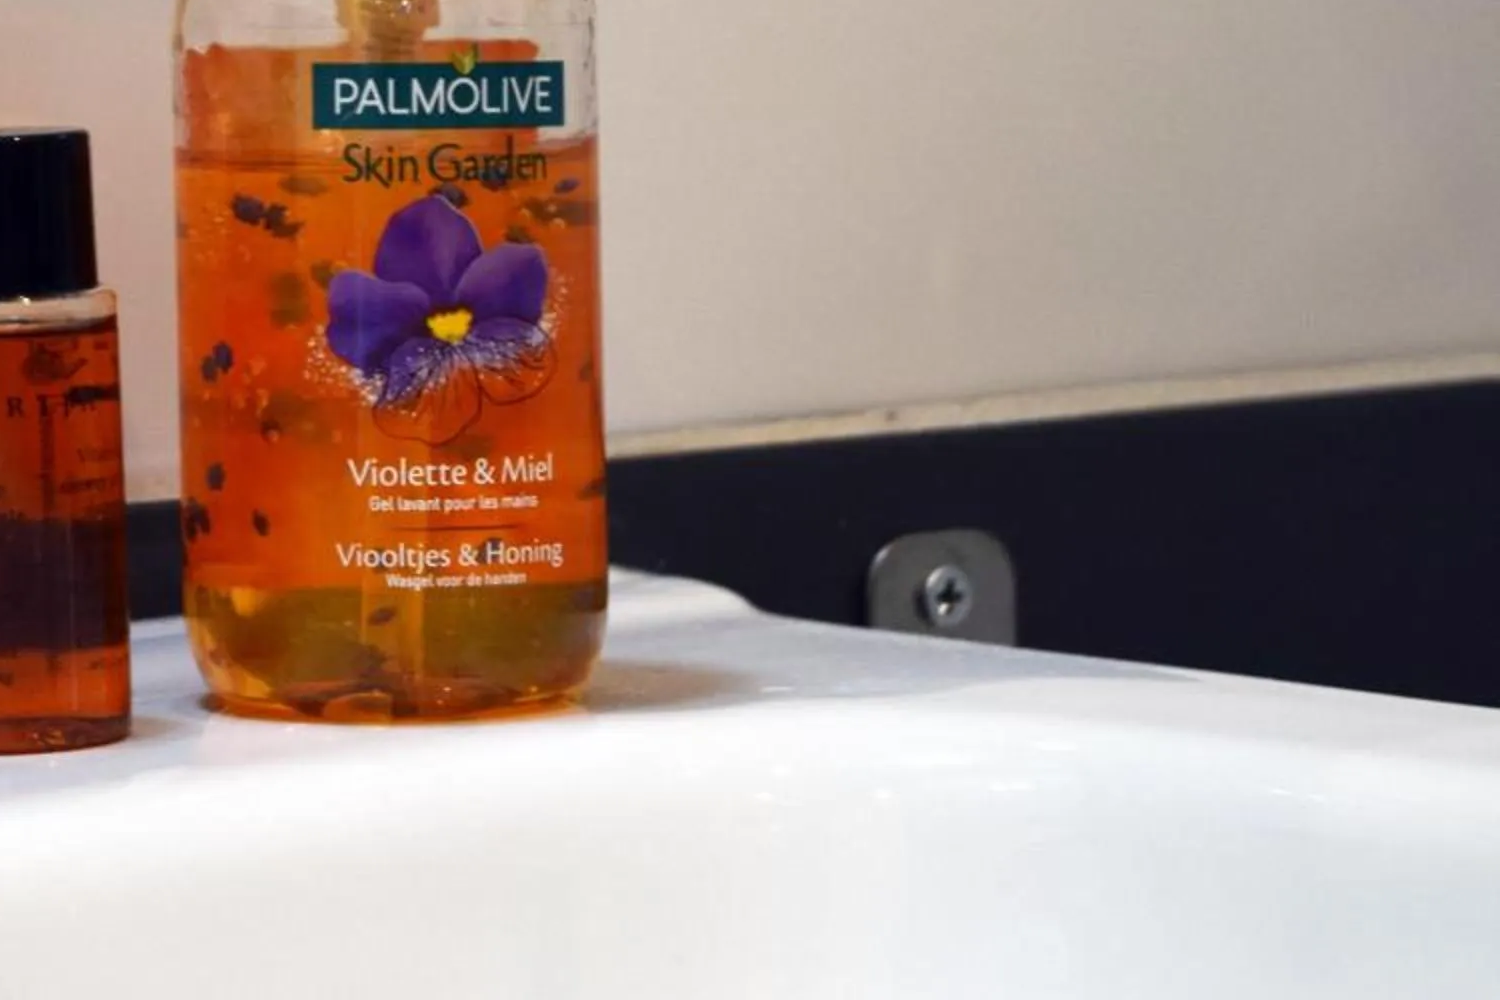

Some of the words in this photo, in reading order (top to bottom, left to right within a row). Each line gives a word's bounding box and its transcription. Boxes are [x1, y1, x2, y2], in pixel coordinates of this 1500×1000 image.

[333, 75, 553, 116] PALMOLIVE
[341, 142, 421, 188] Skin
[427, 135, 548, 183] Garden
[347, 456, 468, 488] Violette
[473, 457, 496, 486] &
[501, 451, 554, 484] Miel
[369, 495, 395, 512] Gel
[397, 495, 441, 512] lavant
[442, 497, 476, 515] pour
[478, 494, 499, 510] les
[500, 493, 539, 509] mains
[335, 542, 452, 575] Viooltjes
[457, 543, 479, 567] &
[486, 537, 565, 568] Honing
[435, 575, 464, 588] voor
[466, 572, 483, 587] de
